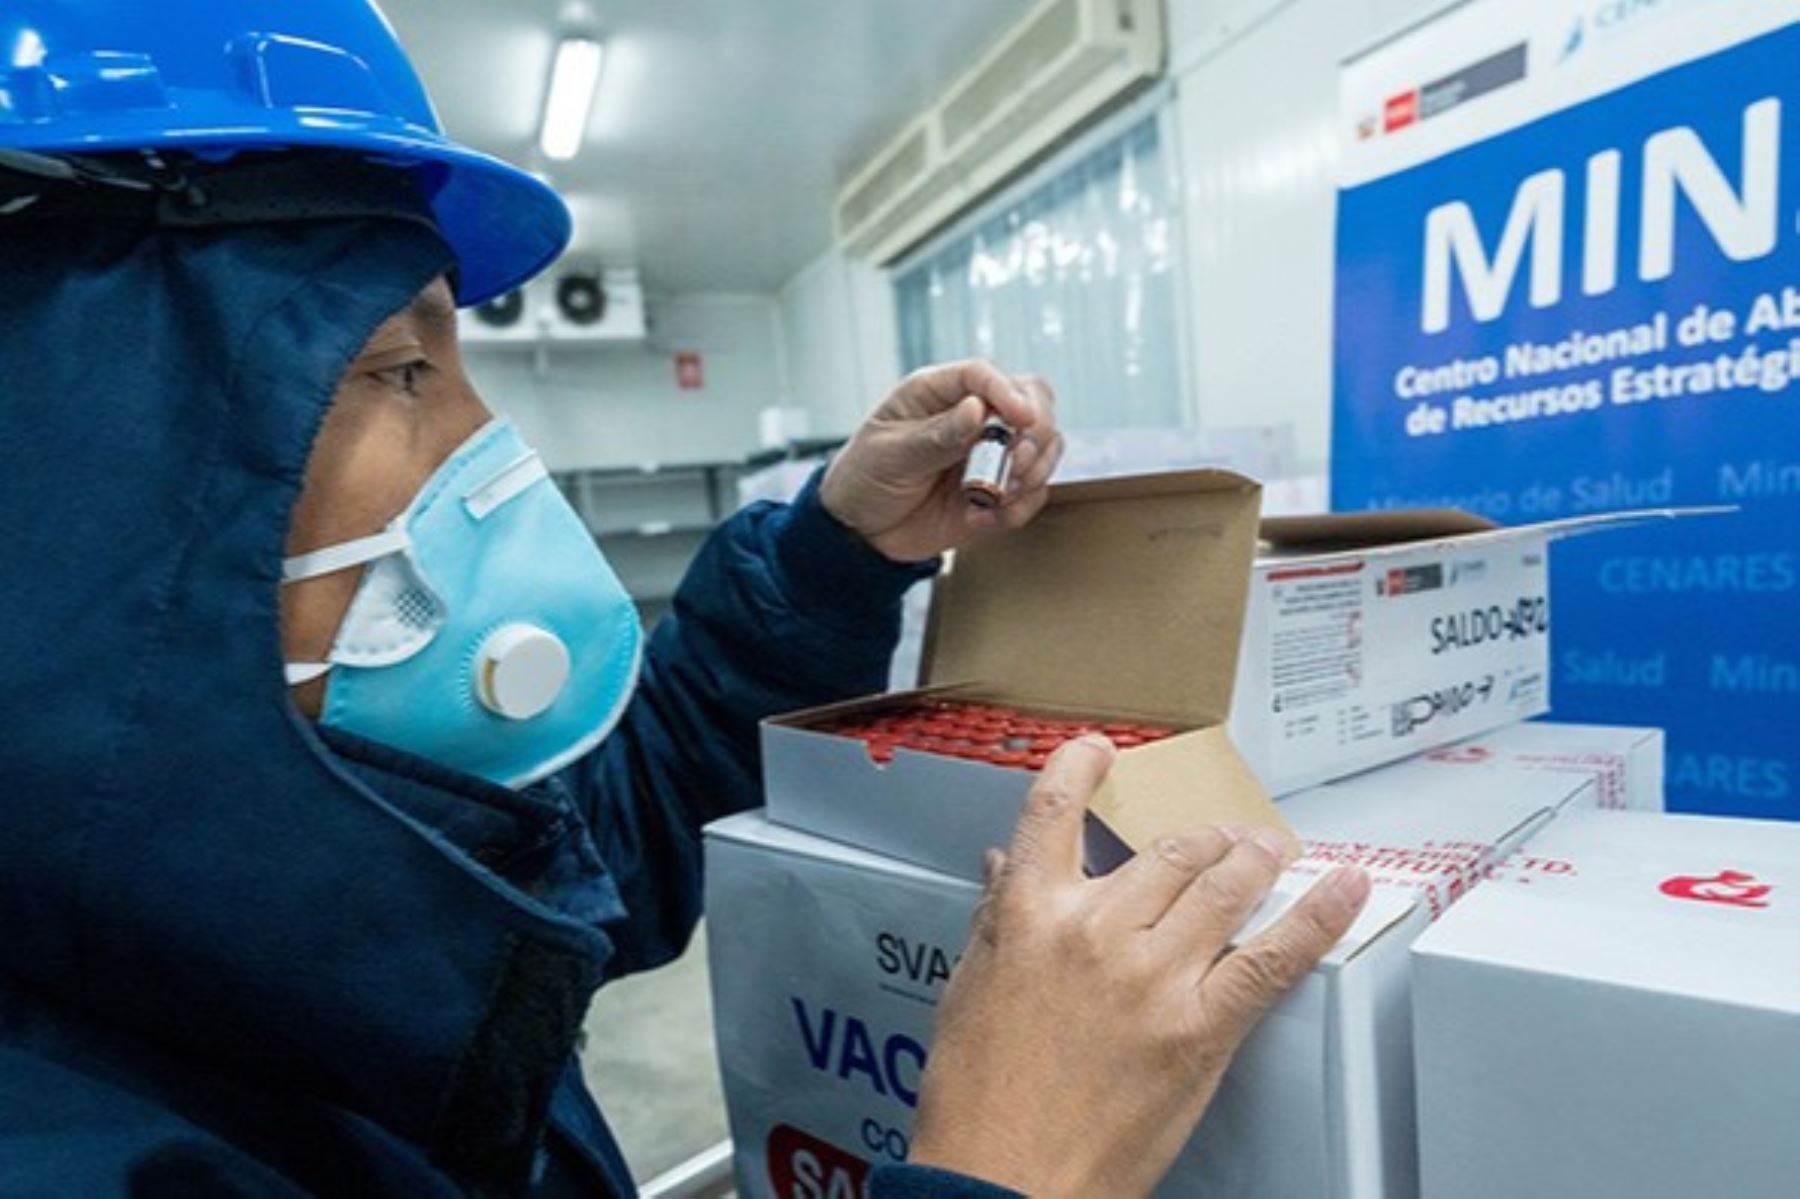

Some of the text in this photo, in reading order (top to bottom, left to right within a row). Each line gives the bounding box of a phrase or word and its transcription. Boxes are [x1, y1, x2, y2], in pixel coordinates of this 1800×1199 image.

[1421, 96, 1800, 334] MIN
[1395, 355, 1498, 399] Centro
[1505, 312, 1667, 378] Nacional
[1677, 305, 1735, 346] de
[1406, 402, 1447, 436] de
[1452, 378, 1603, 430] Recursos
[1519, 481, 1562, 510] de
[1572, 468, 1673, 507] Salud
[1600, 552, 1795, 593] CENARES
[1564, 649, 1665, 687] Salud
[1667, 755, 1788, 799] ARES
[875, 932, 961, 985] SVA
